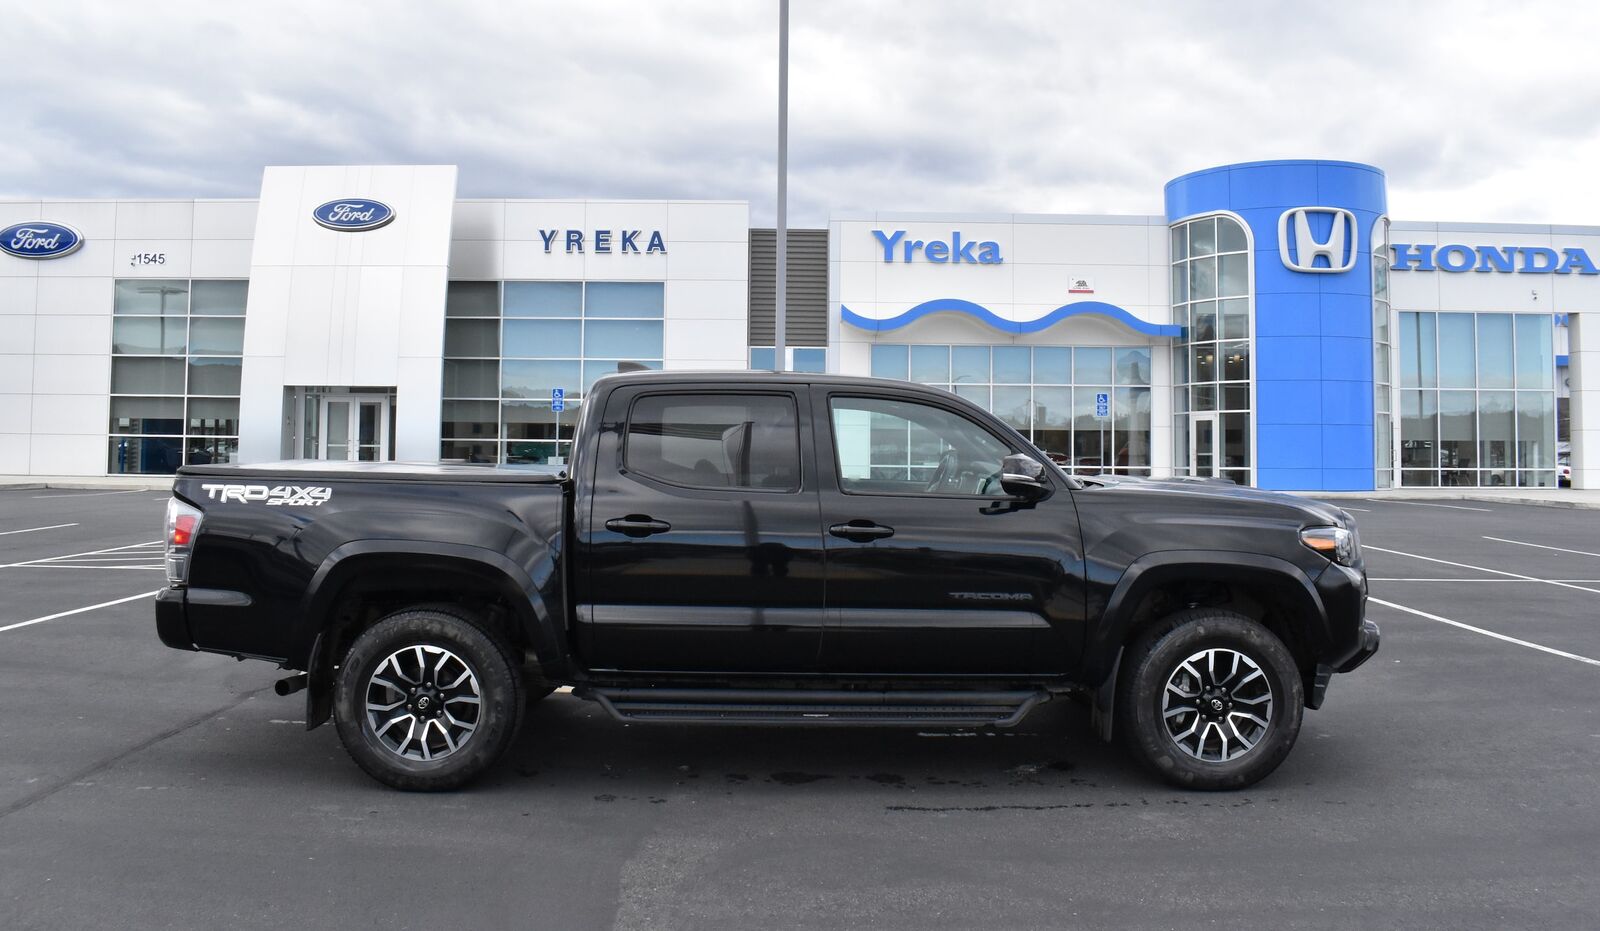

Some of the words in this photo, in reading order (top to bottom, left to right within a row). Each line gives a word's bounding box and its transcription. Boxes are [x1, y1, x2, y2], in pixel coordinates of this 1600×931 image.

[328, 203, 375, 221] Ford
[10, 227, 61, 250] Ford
[539, 229, 667, 254] YREKA
[871, 230, 1004, 264] Yreka
[136, 253, 165, 265] 1545
[1390, 243, 1600, 275] HONDA
[265, 497, 329, 506] SPORT
[949, 592, 1033, 600] TACOMA
